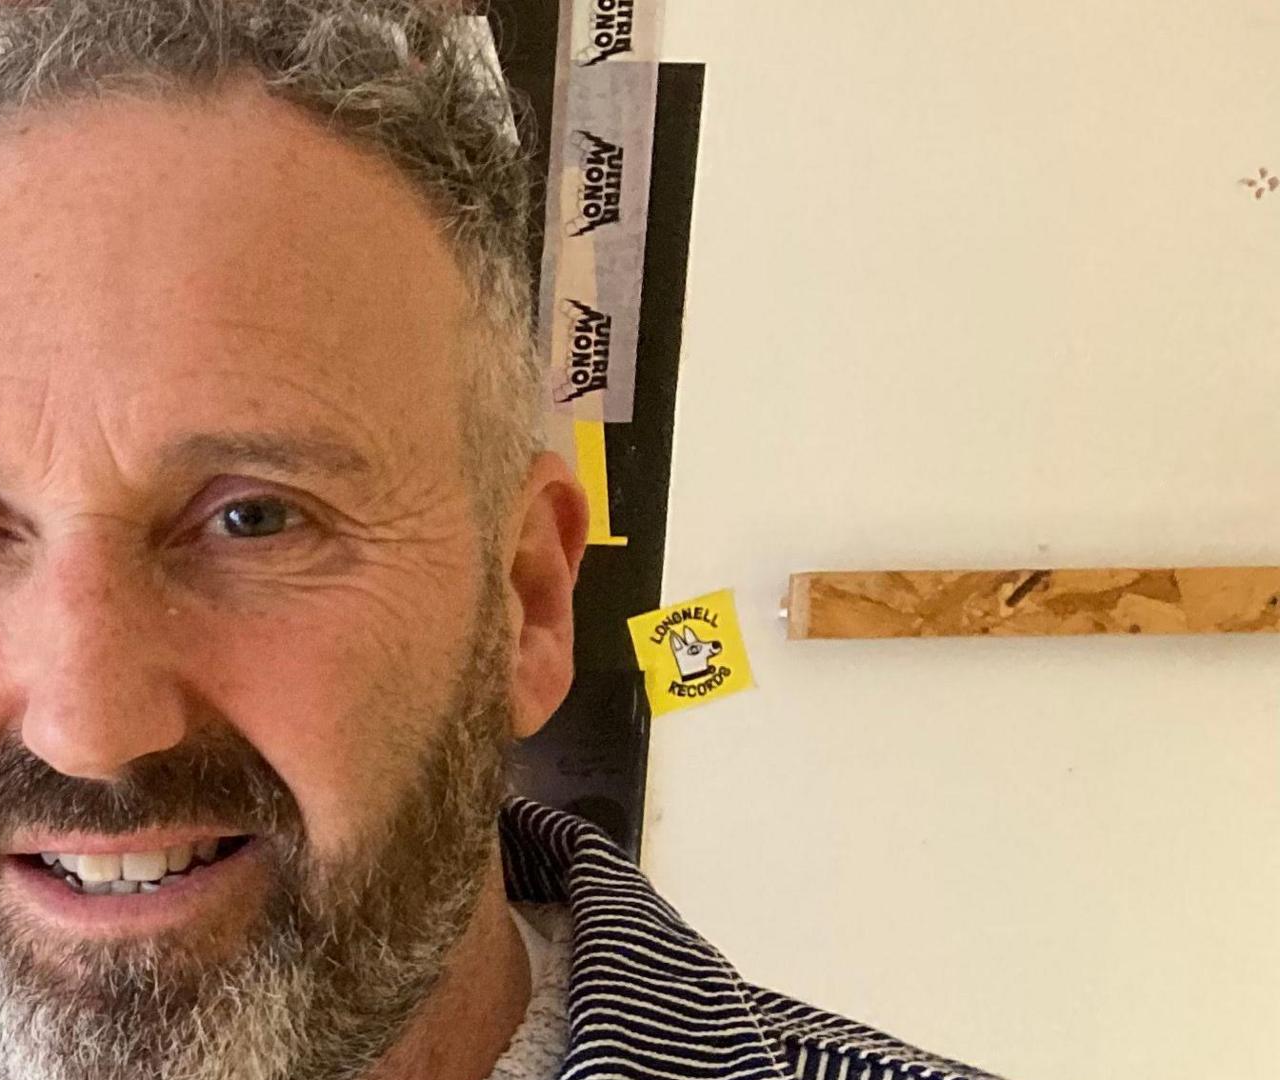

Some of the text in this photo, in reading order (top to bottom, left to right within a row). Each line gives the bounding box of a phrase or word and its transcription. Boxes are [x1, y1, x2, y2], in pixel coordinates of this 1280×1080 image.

[582, 142, 607, 219] MONO
[570, 308, 604, 386] MONO
[668, 665, 732, 698] RECORDS
